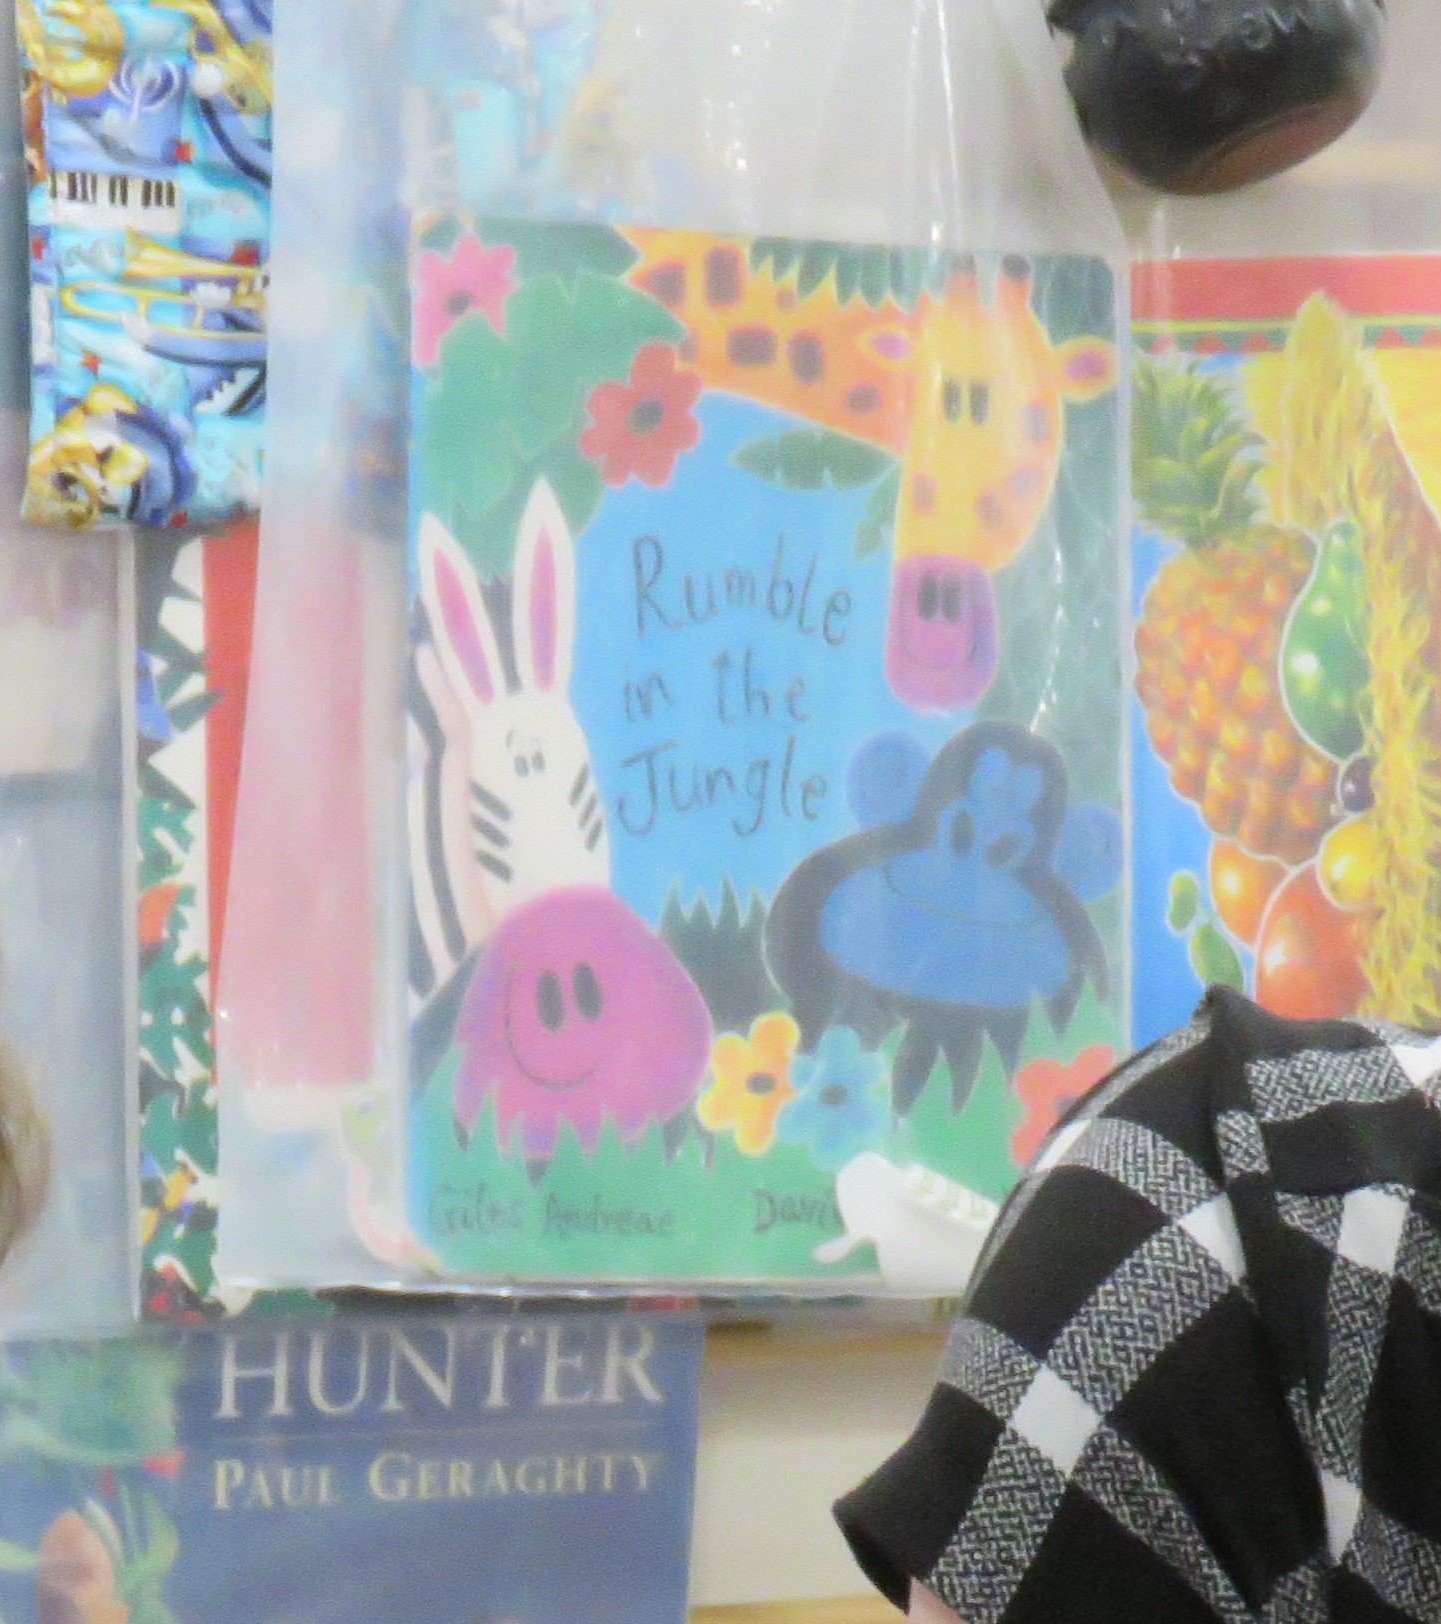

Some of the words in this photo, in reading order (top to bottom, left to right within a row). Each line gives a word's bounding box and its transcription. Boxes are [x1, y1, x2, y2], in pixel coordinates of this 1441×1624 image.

[631, 531, 853, 646] Rumble
[622, 661, 675, 723] in
[710, 645, 809, 724] the
[616, 735, 828, 838] Jungle
[214, 1324, 664, 1418] HUNTER
[214, 1458, 339, 1510] PAUL
[367, 1452, 660, 1502] GERAGHTY
